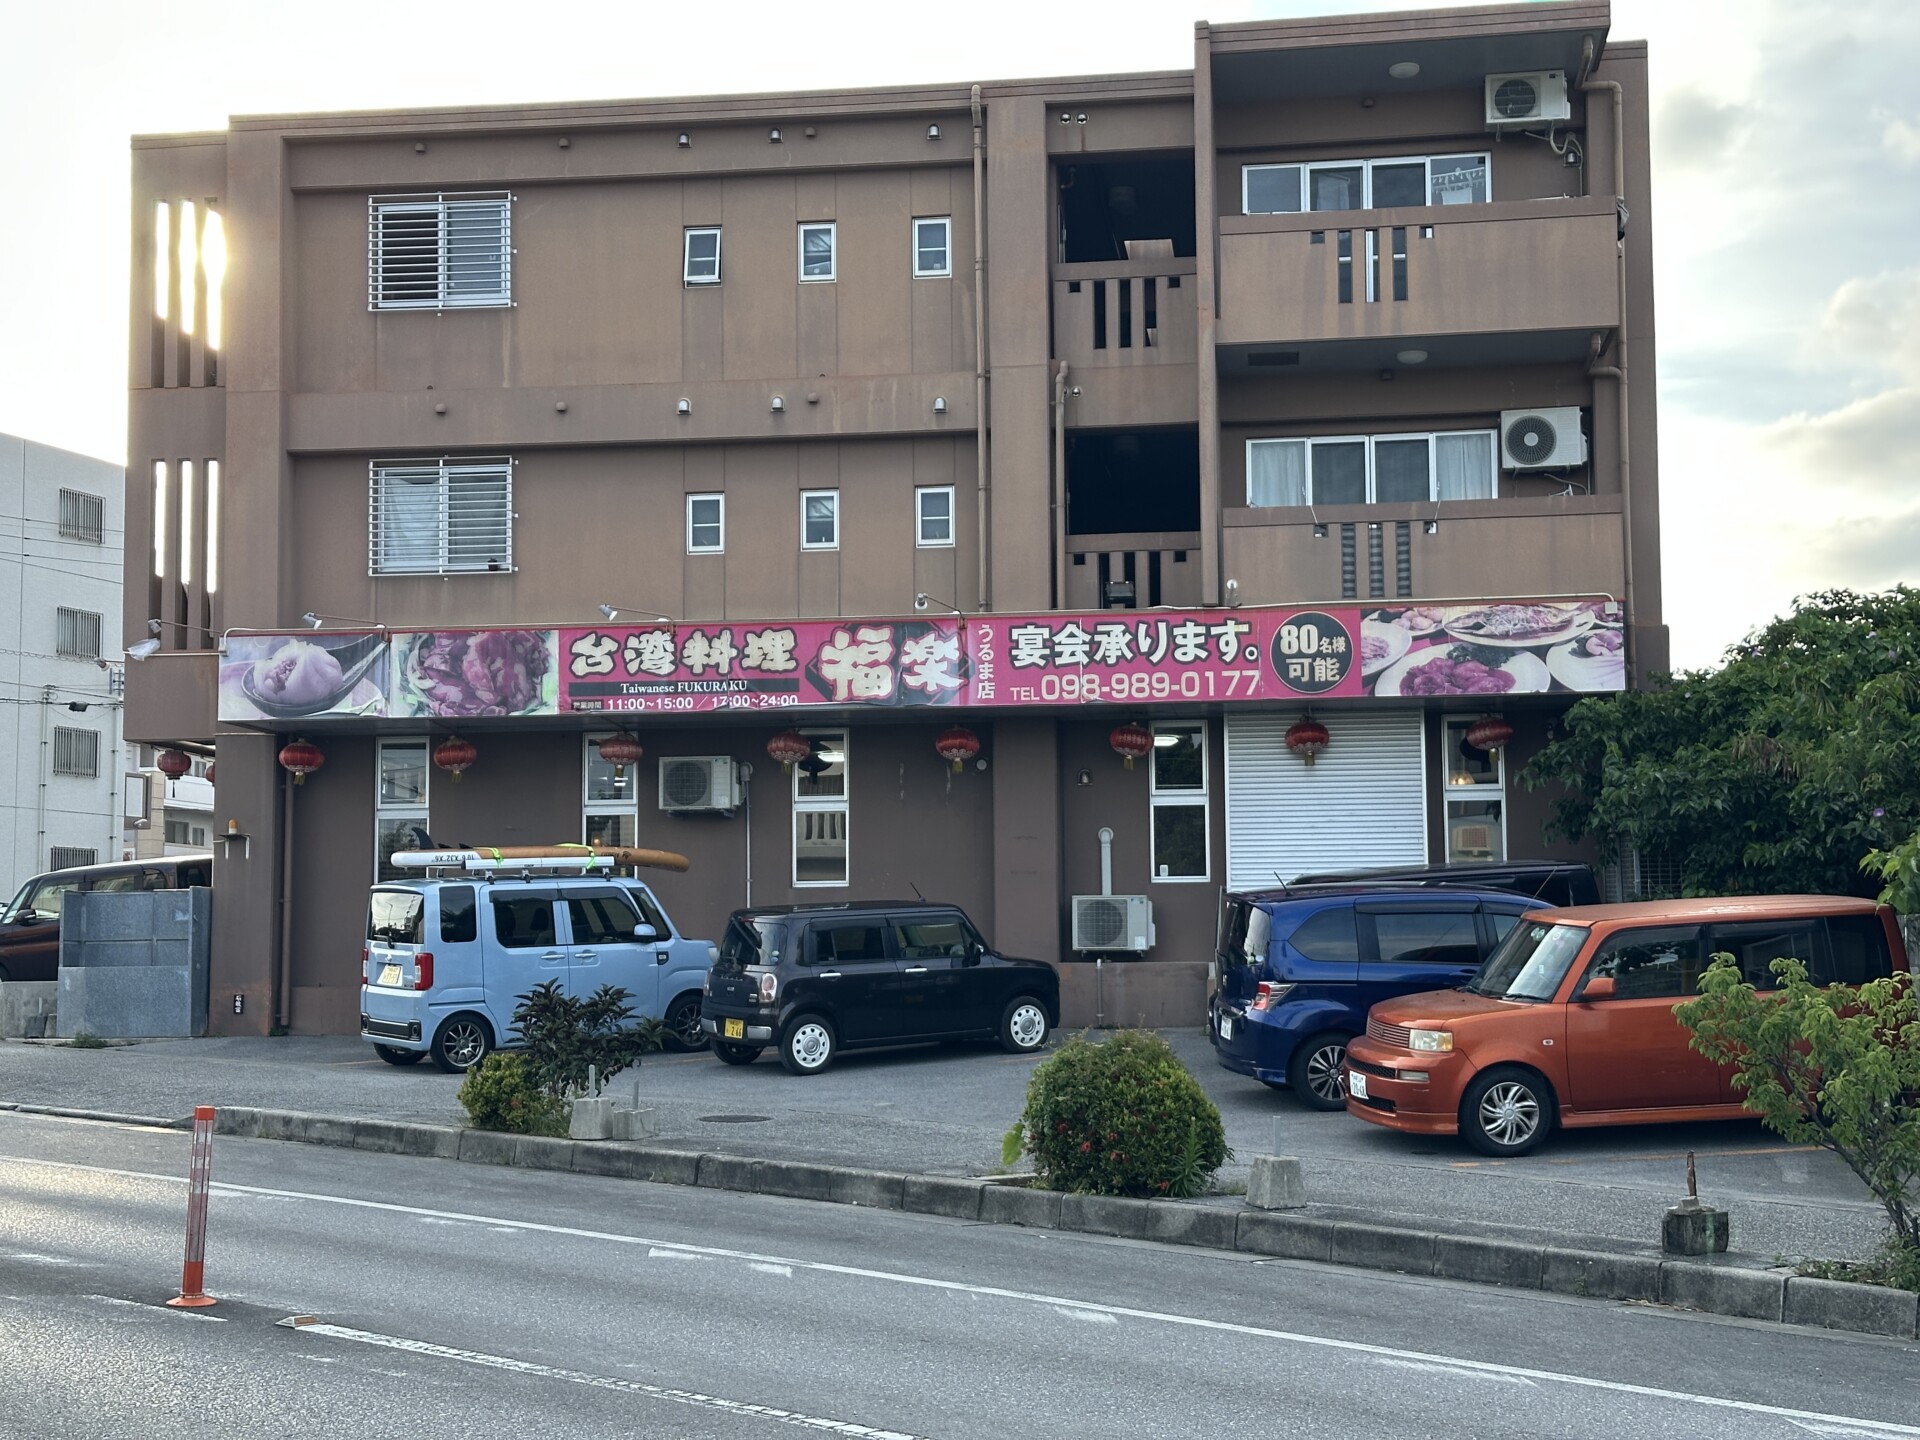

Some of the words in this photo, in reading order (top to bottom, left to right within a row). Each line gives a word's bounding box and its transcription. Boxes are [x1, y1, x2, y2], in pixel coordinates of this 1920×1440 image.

[570, 627, 799, 677] 台湾料理
[819, 626, 967, 701] 福楽
[977, 623, 995, 700] うるま店
[1010, 619, 1259, 667] 宴会承ります。
[621, 683, 675, 694] Taiwanese
[677, 680, 748, 693] FUKURAKU
[1010, 687, 1040, 701] TEL
[1041, 670, 1260, 701] 098-989-0177
[1286, 657, 1340, 683] 可能
